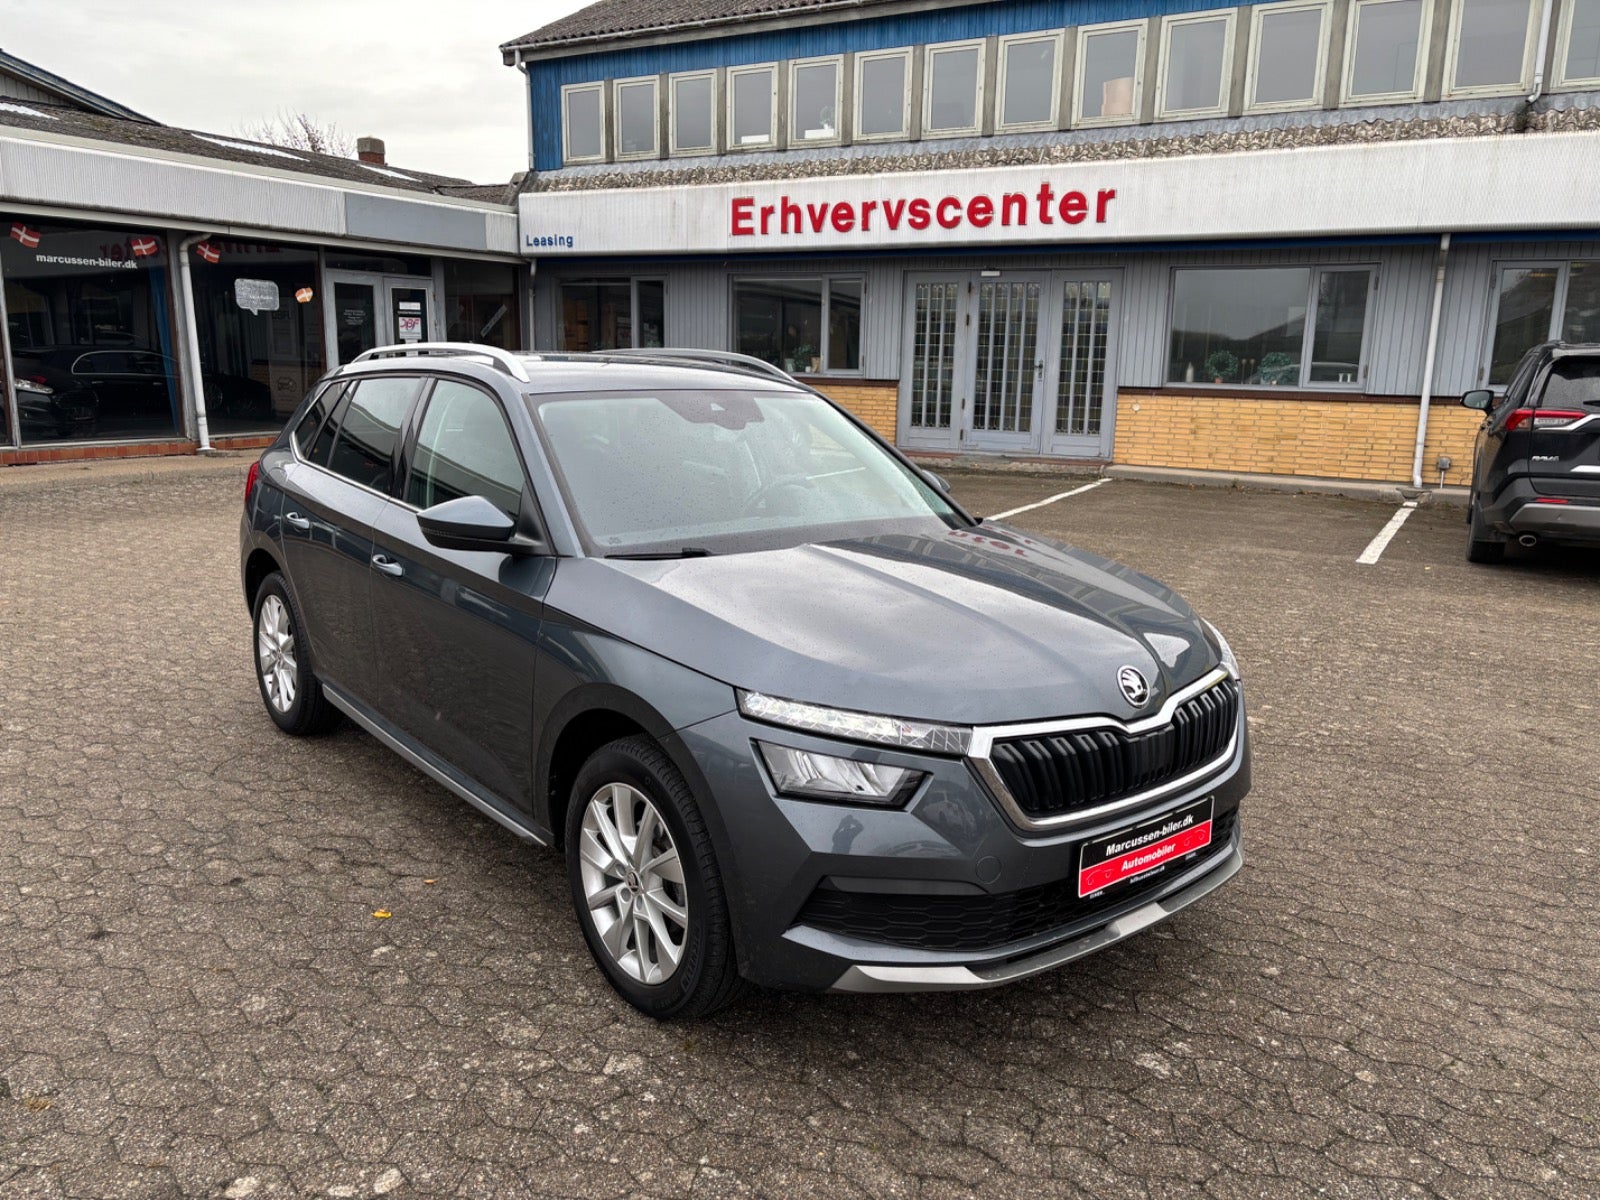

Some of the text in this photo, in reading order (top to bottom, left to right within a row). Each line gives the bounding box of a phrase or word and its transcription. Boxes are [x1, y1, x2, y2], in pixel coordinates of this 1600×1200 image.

[730, 183, 1117, 236] Erhvervscenter
[525, 233, 574, 249] Leasing
[35, 253, 138, 269] marcussen-biler.dk
[1106, 814, 1194, 857] Marcussen-biler.dk
[1121, 843, 1176, 872] Automobiler
